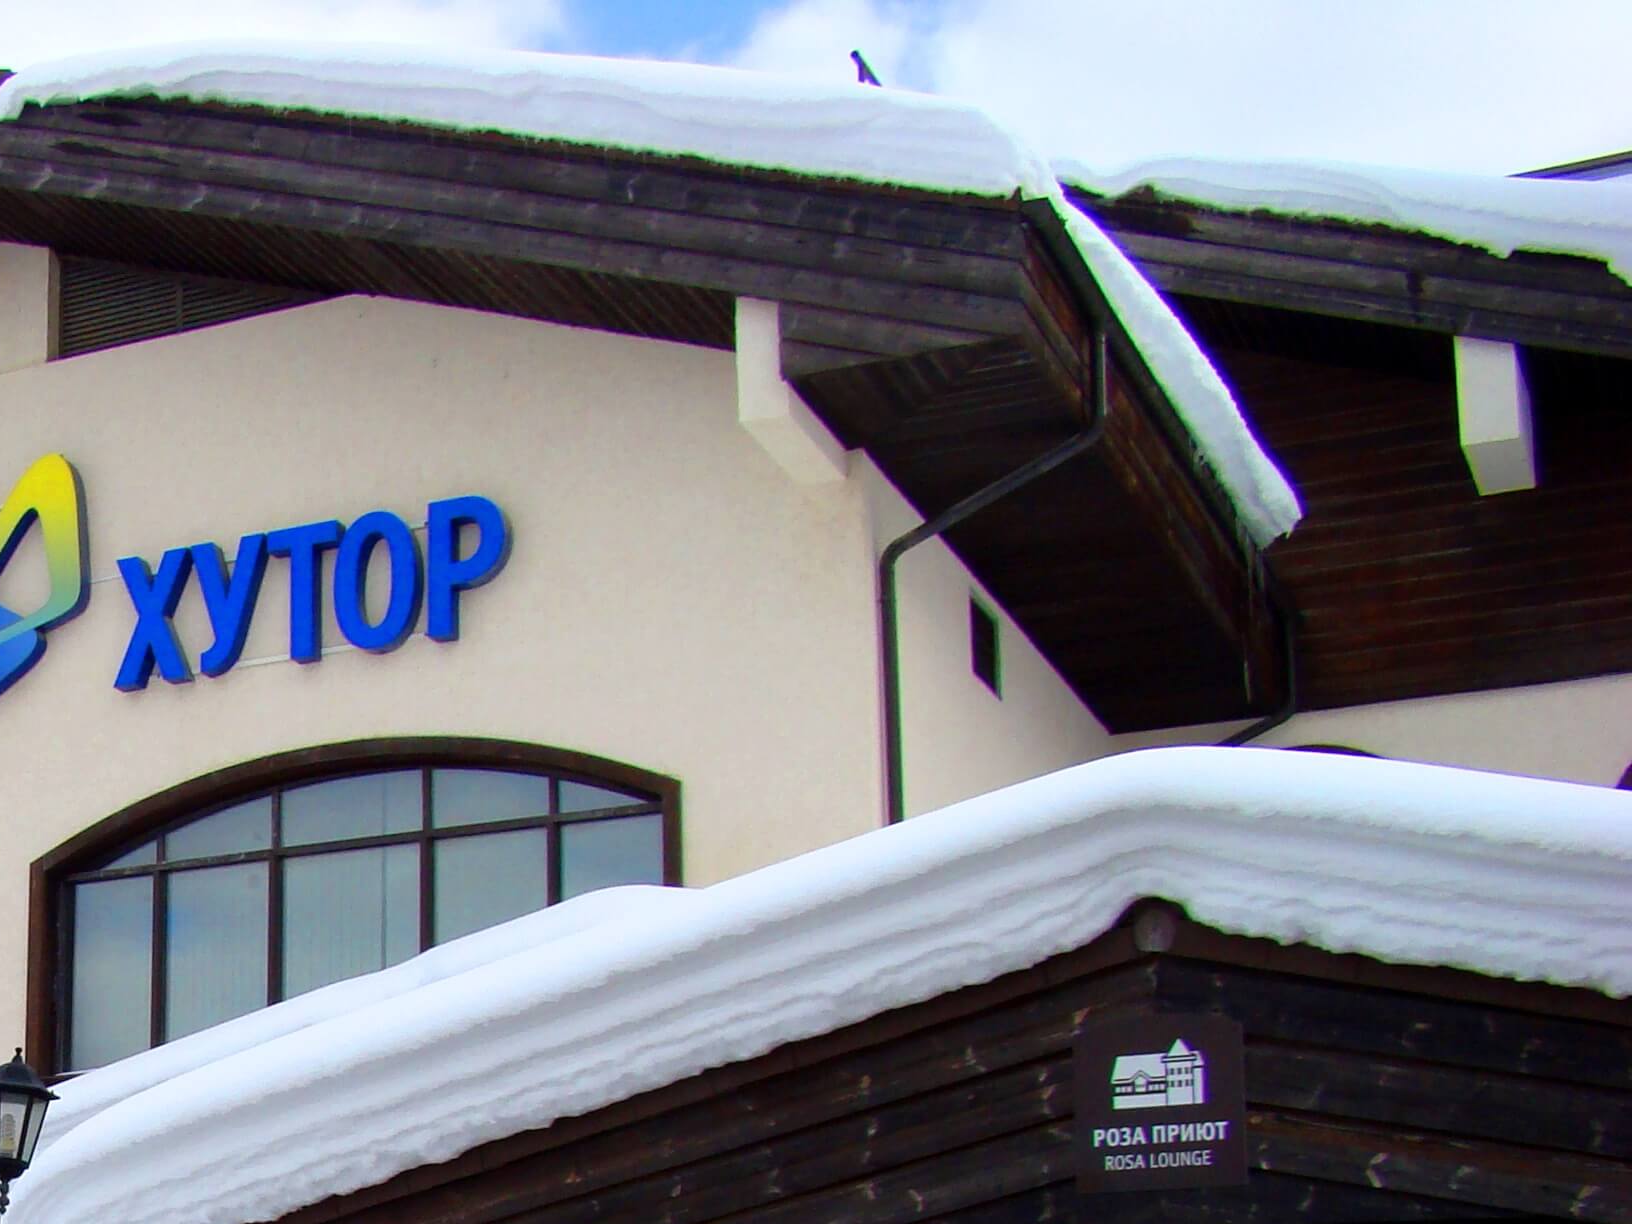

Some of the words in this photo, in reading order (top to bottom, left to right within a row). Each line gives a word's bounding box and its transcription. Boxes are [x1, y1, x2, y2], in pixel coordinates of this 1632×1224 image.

[112, 494, 514, 692] ХУТОР
[1093, 1126, 1147, 1148] РОЗА
[1152, 1121, 1229, 1145] ПРИЮТ
[1104, 1154, 1146, 1171] ROSA
[1150, 1150, 1212, 1169] LOUNGE
